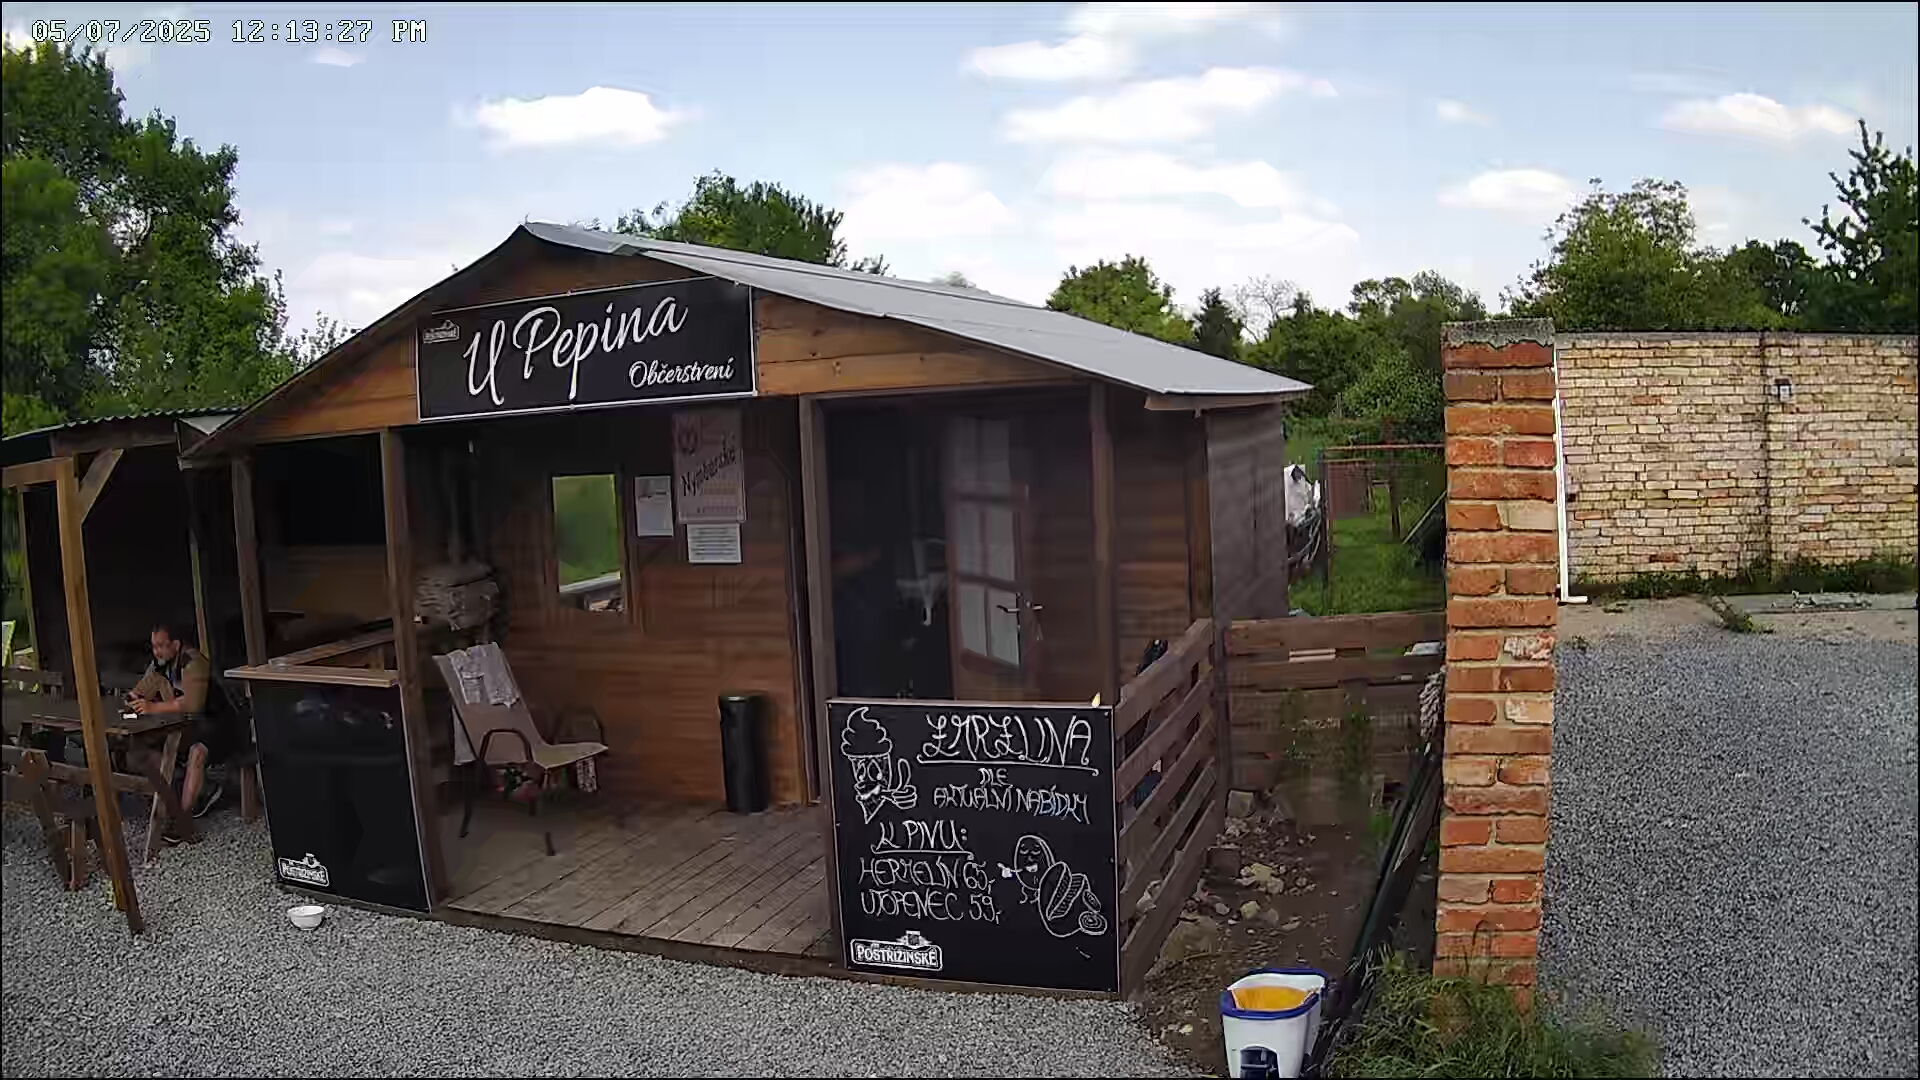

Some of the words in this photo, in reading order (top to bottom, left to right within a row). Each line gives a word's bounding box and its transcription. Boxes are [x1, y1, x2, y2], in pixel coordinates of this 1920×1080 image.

[463, 319, 505, 405] U
[512, 296, 689, 400] Pepina
[628, 356, 735, 389] Občerstvení
[922, 714, 1092, 767] ZMRZLINA
[978, 767, 1010, 787] DLE
[1015, 785, 1091, 825] NABÍDKY
[876, 821, 901, 850] K
[902, 819, 968, 851] PIVU:
[858, 855, 959, 889] HERMELÍN
[860, 888, 964, 920] UTOPENEC
